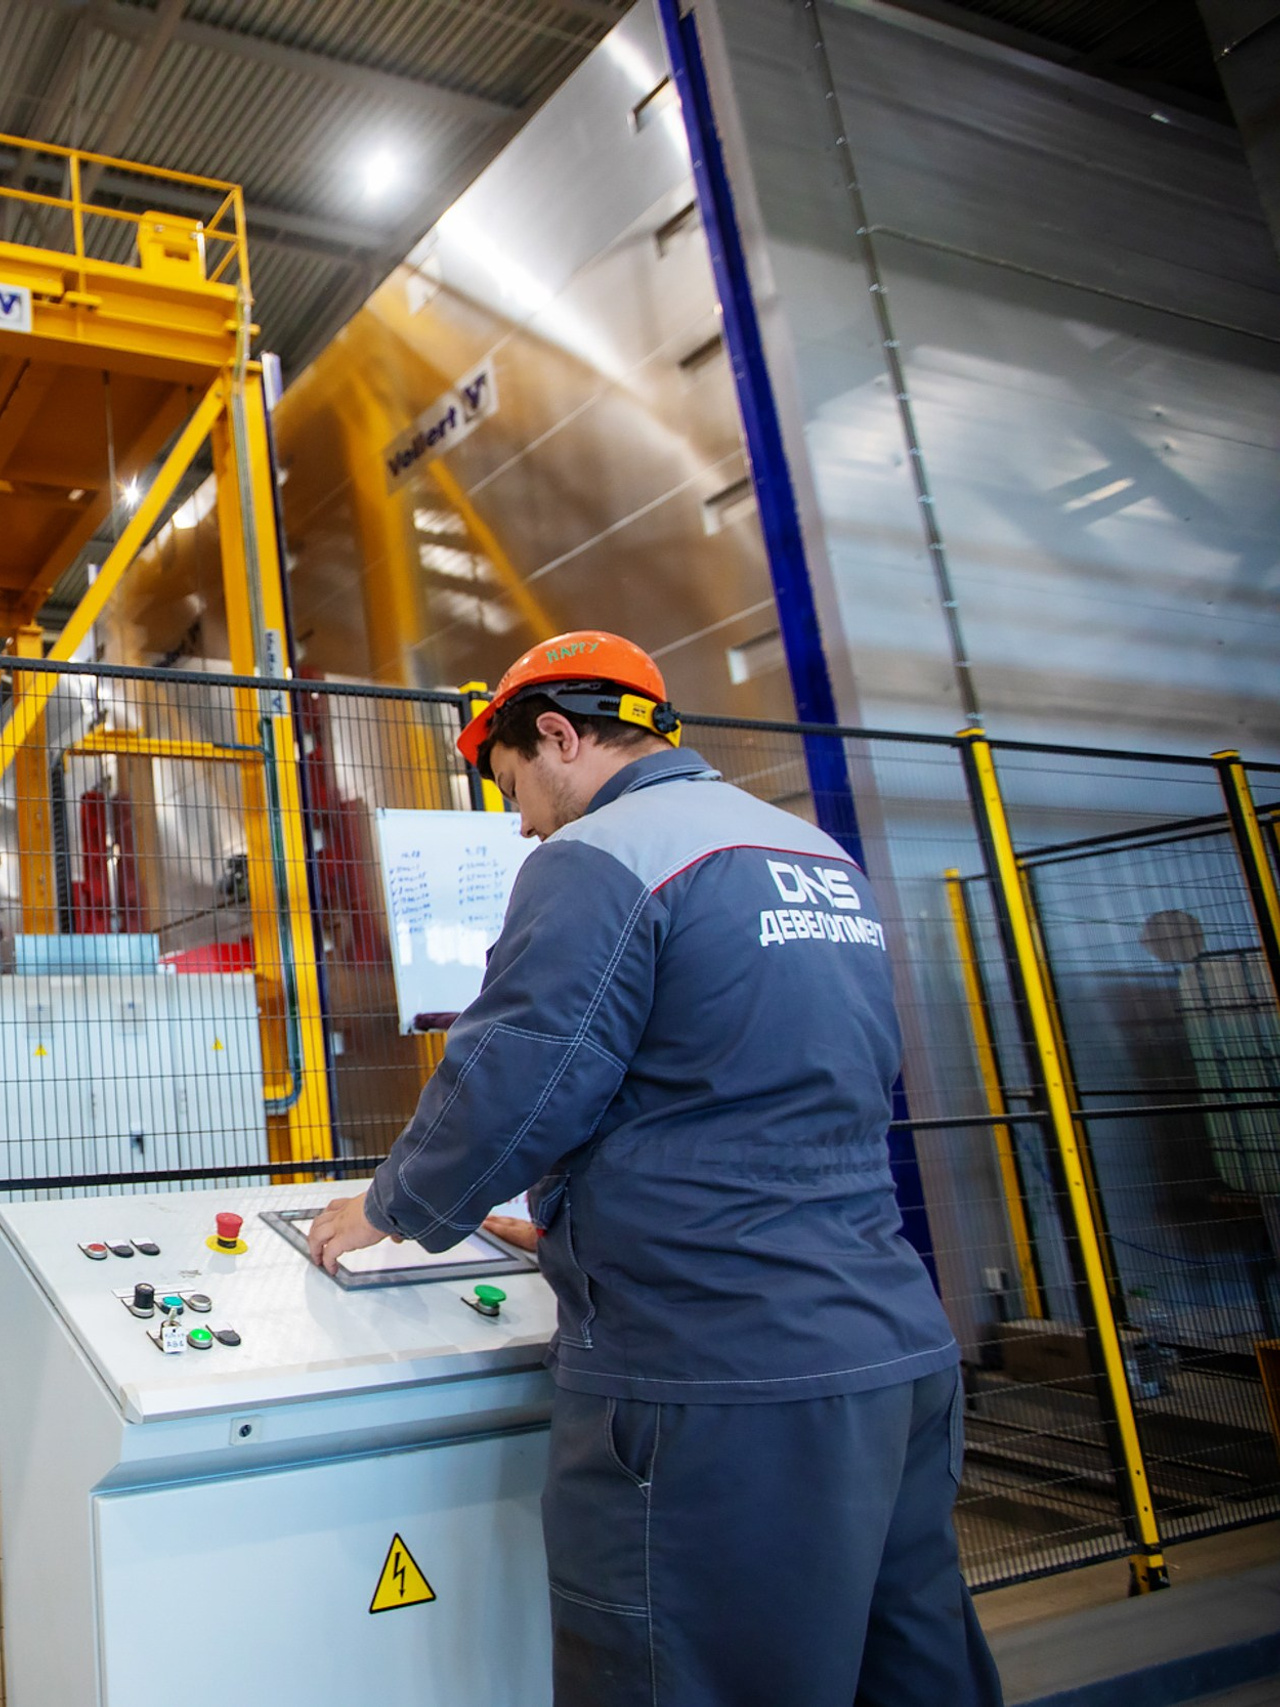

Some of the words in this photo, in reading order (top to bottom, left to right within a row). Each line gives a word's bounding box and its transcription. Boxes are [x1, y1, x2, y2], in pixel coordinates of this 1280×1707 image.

[388, 406, 456, 477] Vollert
[545, 641, 600, 664] HAPPY
[766, 859, 861, 910] DNS
[759, 909, 886, 951] ДЕВЕЛОПМЕТ
